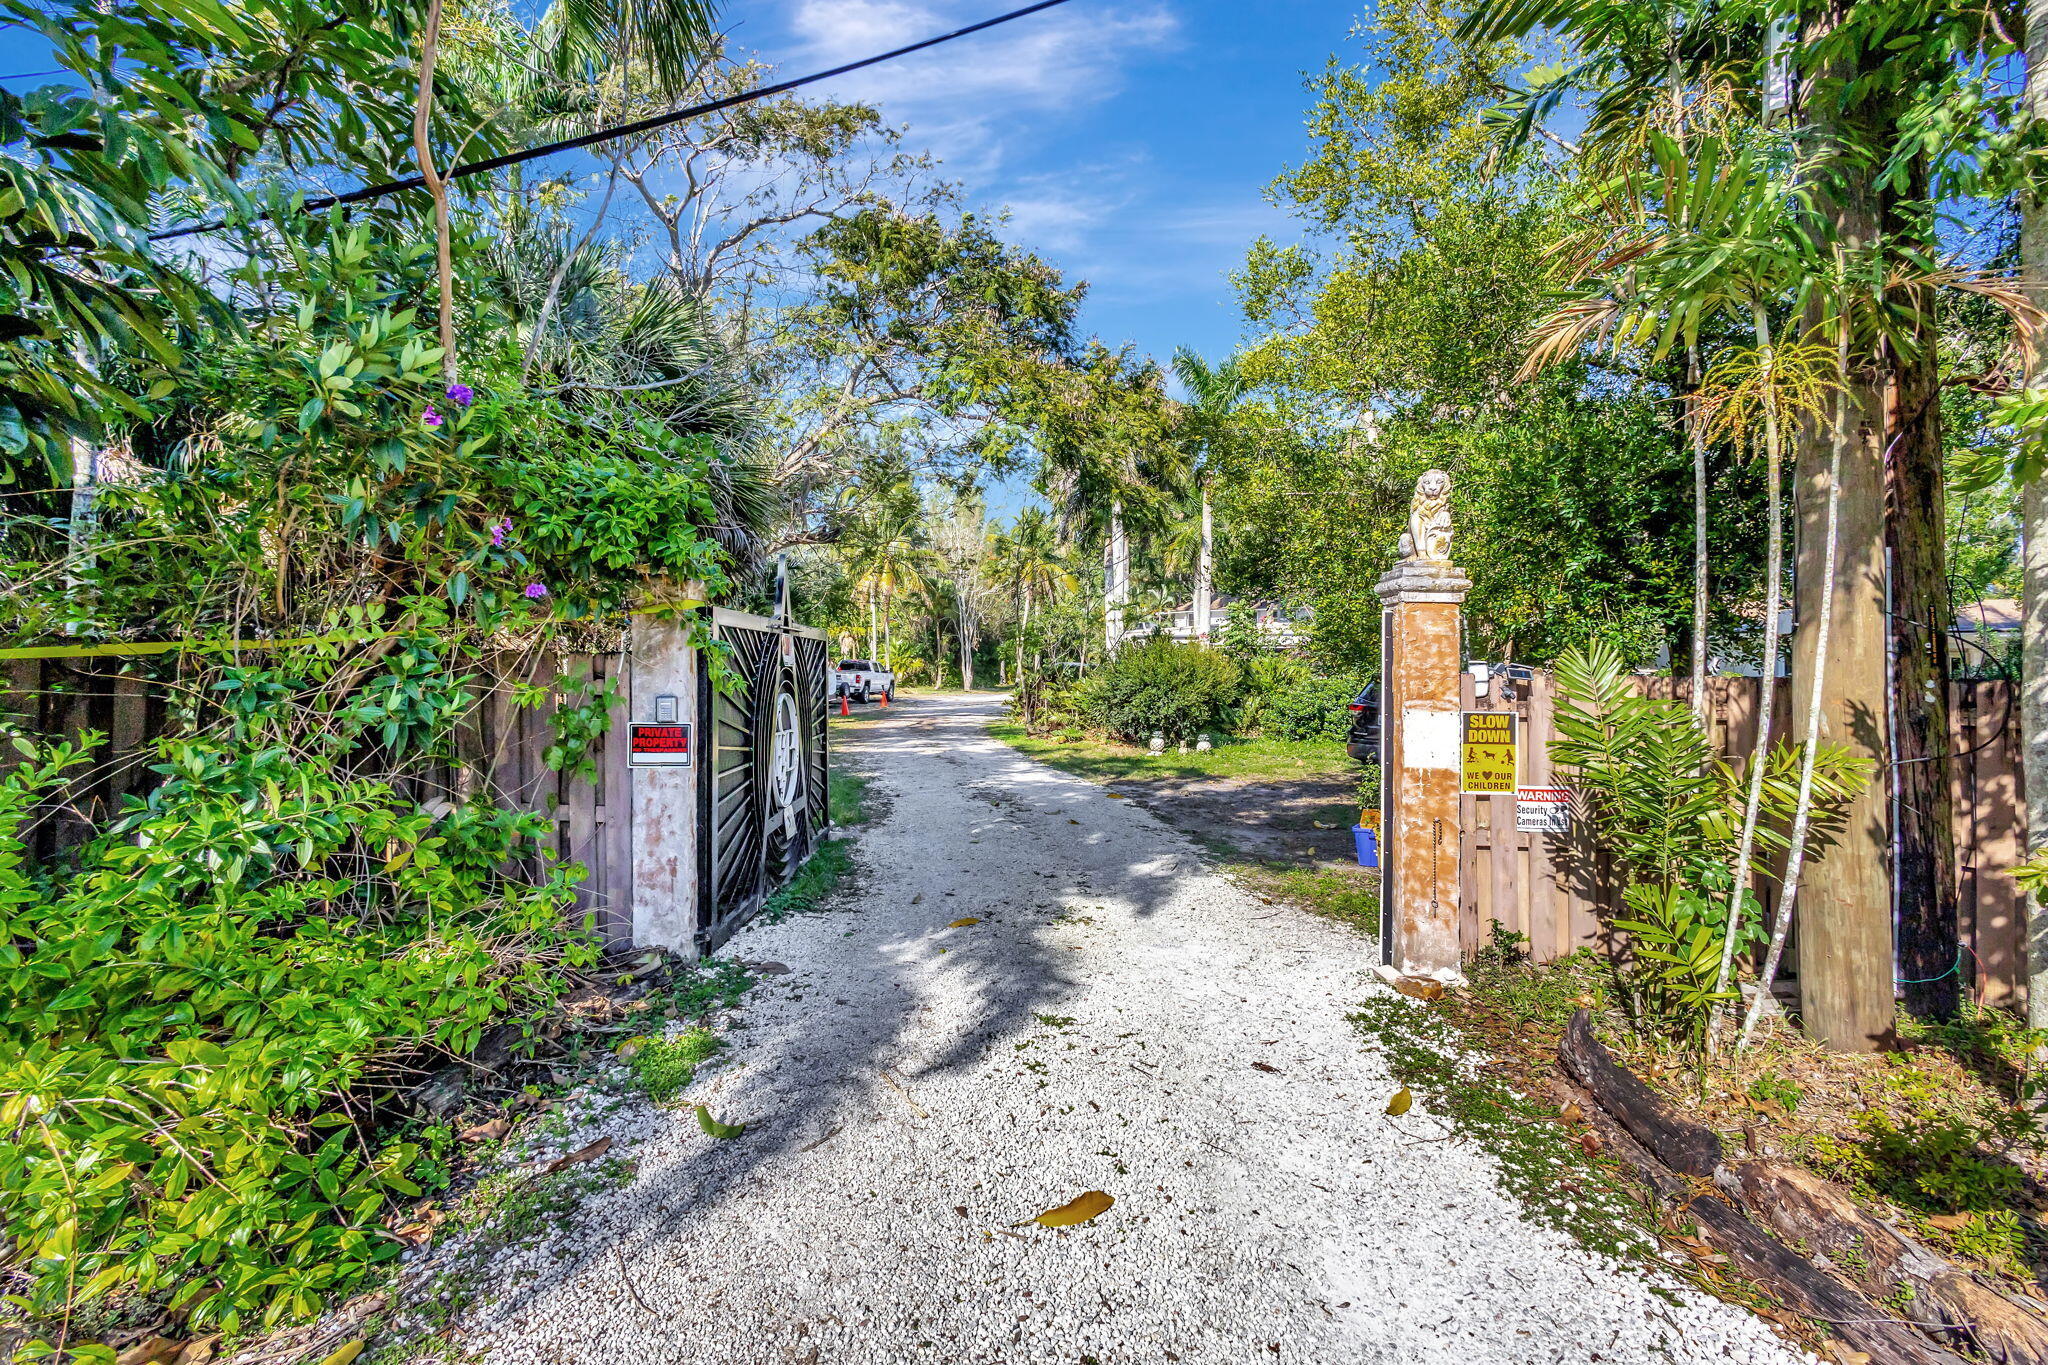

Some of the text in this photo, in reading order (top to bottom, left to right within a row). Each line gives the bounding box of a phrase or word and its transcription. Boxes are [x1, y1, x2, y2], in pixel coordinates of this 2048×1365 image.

[1469, 715, 1510, 728] SLOW
[638, 727, 682, 737] PRIVATE
[1468, 730, 1510, 742] DOWN
[633, 738, 688, 747] PROPERTY
[1494, 772, 1512, 780] OUR
[1518, 791, 1569, 801] WARNING
[1517, 805, 1548, 817] Security
[1517, 816, 1548, 826] Cameras
